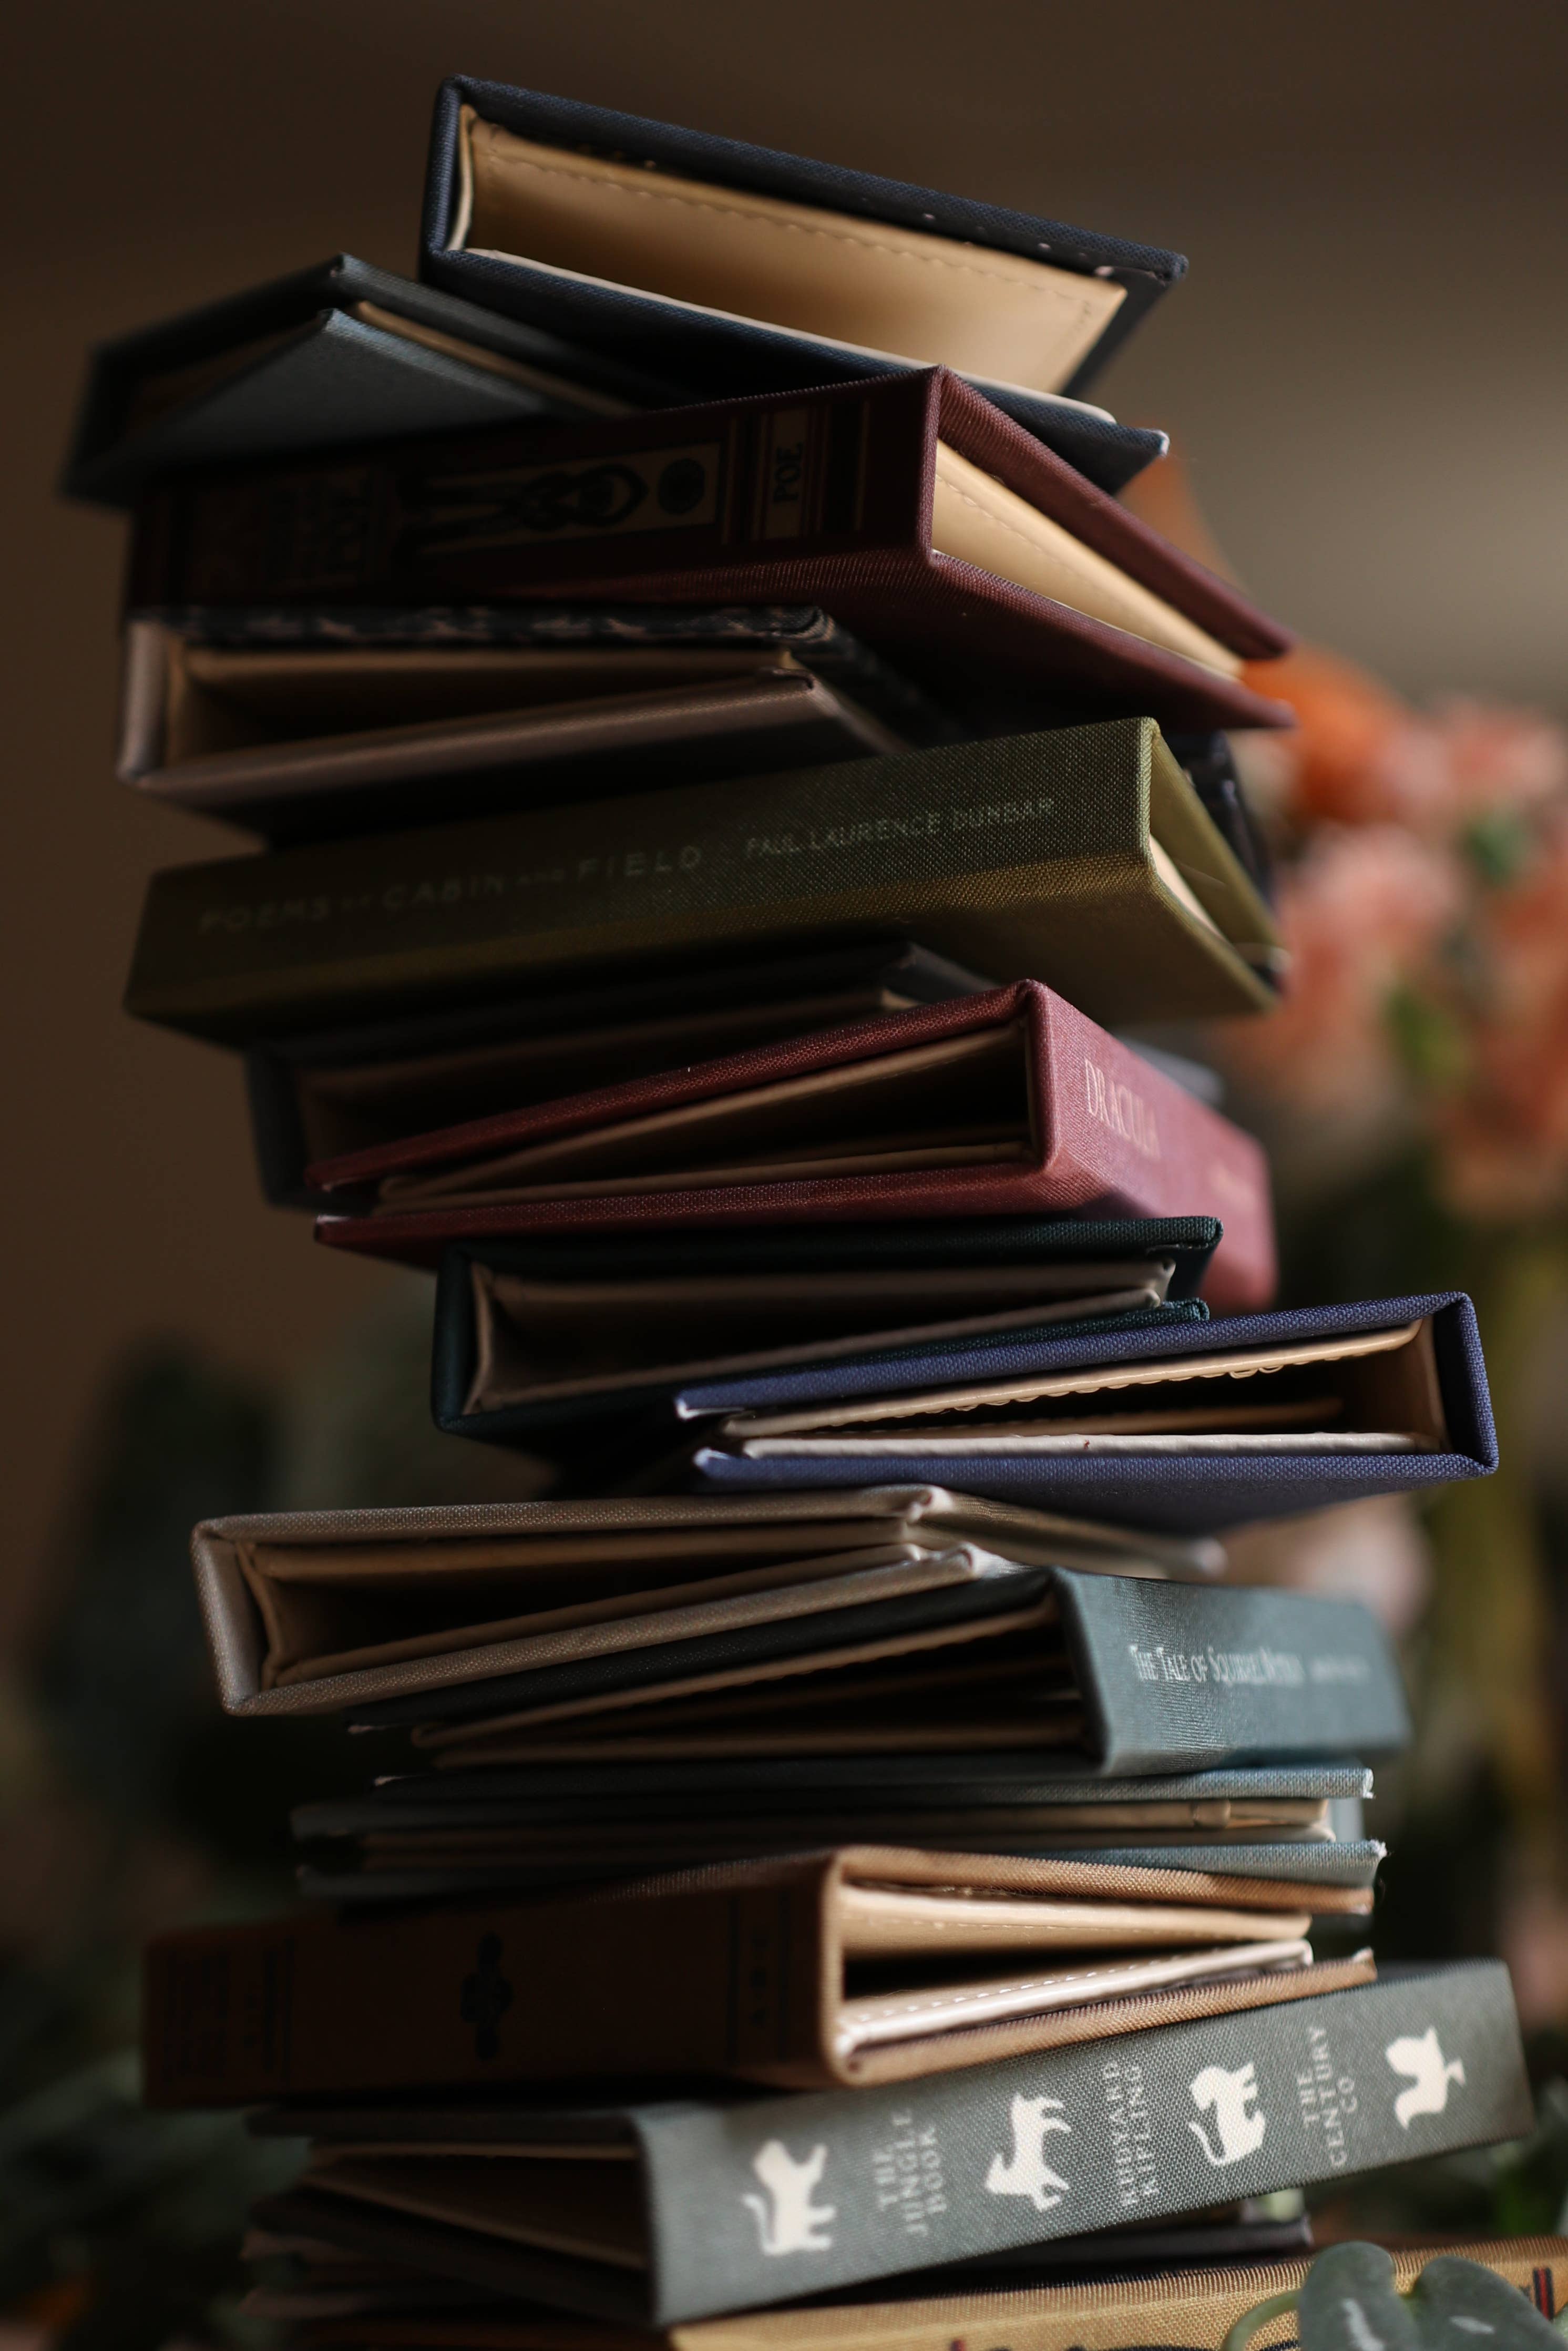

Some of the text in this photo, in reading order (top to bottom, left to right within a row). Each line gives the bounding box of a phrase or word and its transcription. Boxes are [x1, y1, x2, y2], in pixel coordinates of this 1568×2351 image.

[774, 442, 803, 503] POE
[745, 796, 1055, 860] PAUL LAURENCE DUNBAR
[197, 895, 332, 935] POEMS
[381, 874, 506, 912] CABIN
[577, 844, 702, 882] FIELD
[1129, 1644, 1157, 1681] THE
[1156, 1647, 1191, 1681] TALE
[1190, 1654, 1208, 1682] OF
[1103, 2061, 1139, 2206] RUDYARD
[1124, 2064, 1160, 2196] KIPLING
[1297, 2069, 1320, 2128] THE
[1308, 2026, 1348, 2168] CENTURY
[1337, 2076, 1358, 2113] CO
[872, 2146, 898, 2213] THE
[889, 2107, 929, 2236] JUNGLE
[915, 2124, 948, 2215] BOOK
